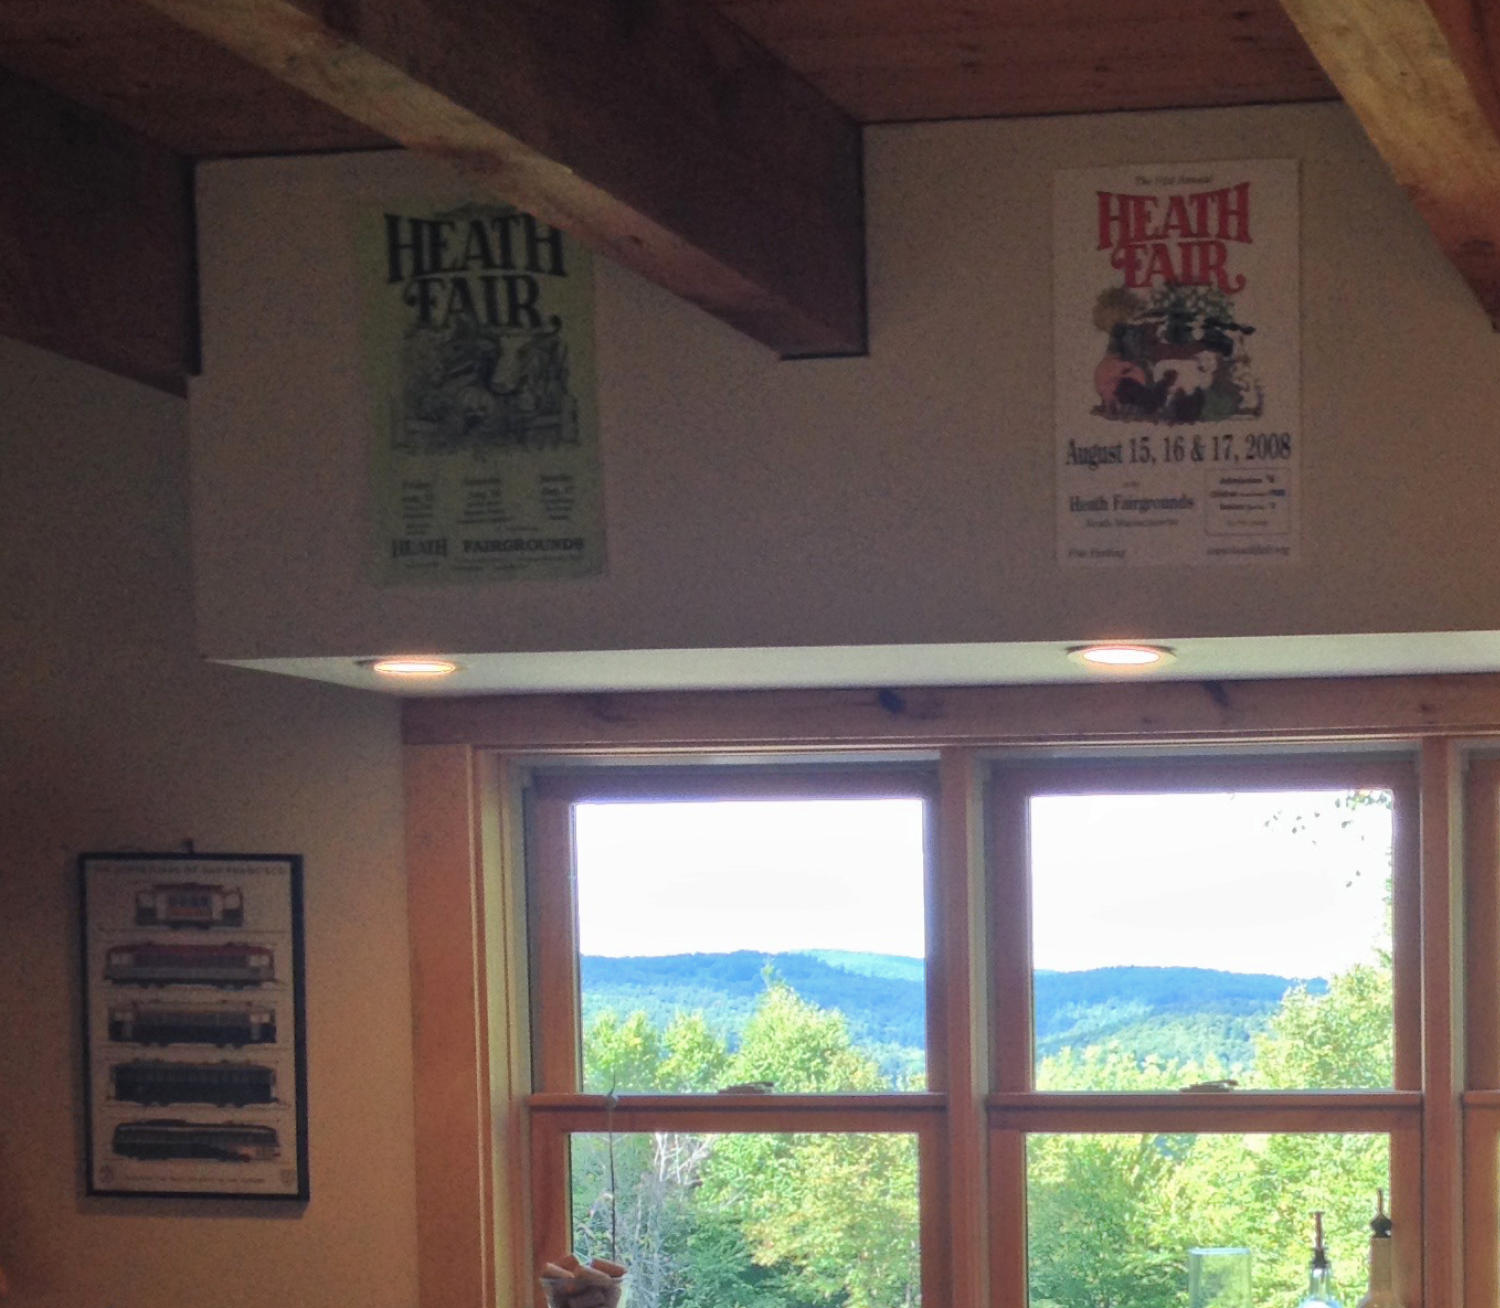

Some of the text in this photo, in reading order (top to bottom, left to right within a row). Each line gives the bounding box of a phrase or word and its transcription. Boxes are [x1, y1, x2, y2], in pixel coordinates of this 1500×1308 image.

[1097, 182, 1252, 251] HEATH
[384, 211, 569, 284] HEATH
[1111, 240, 1246, 295] FAIR
[403, 275, 563, 336] FAIR
[1066, 432, 1292, 470] August 15, 16 & 17, 2008
[1068, 494, 1195, 514] Heath Fairgrounds
[463, 537, 585, 553] FAIRGROUNDS
